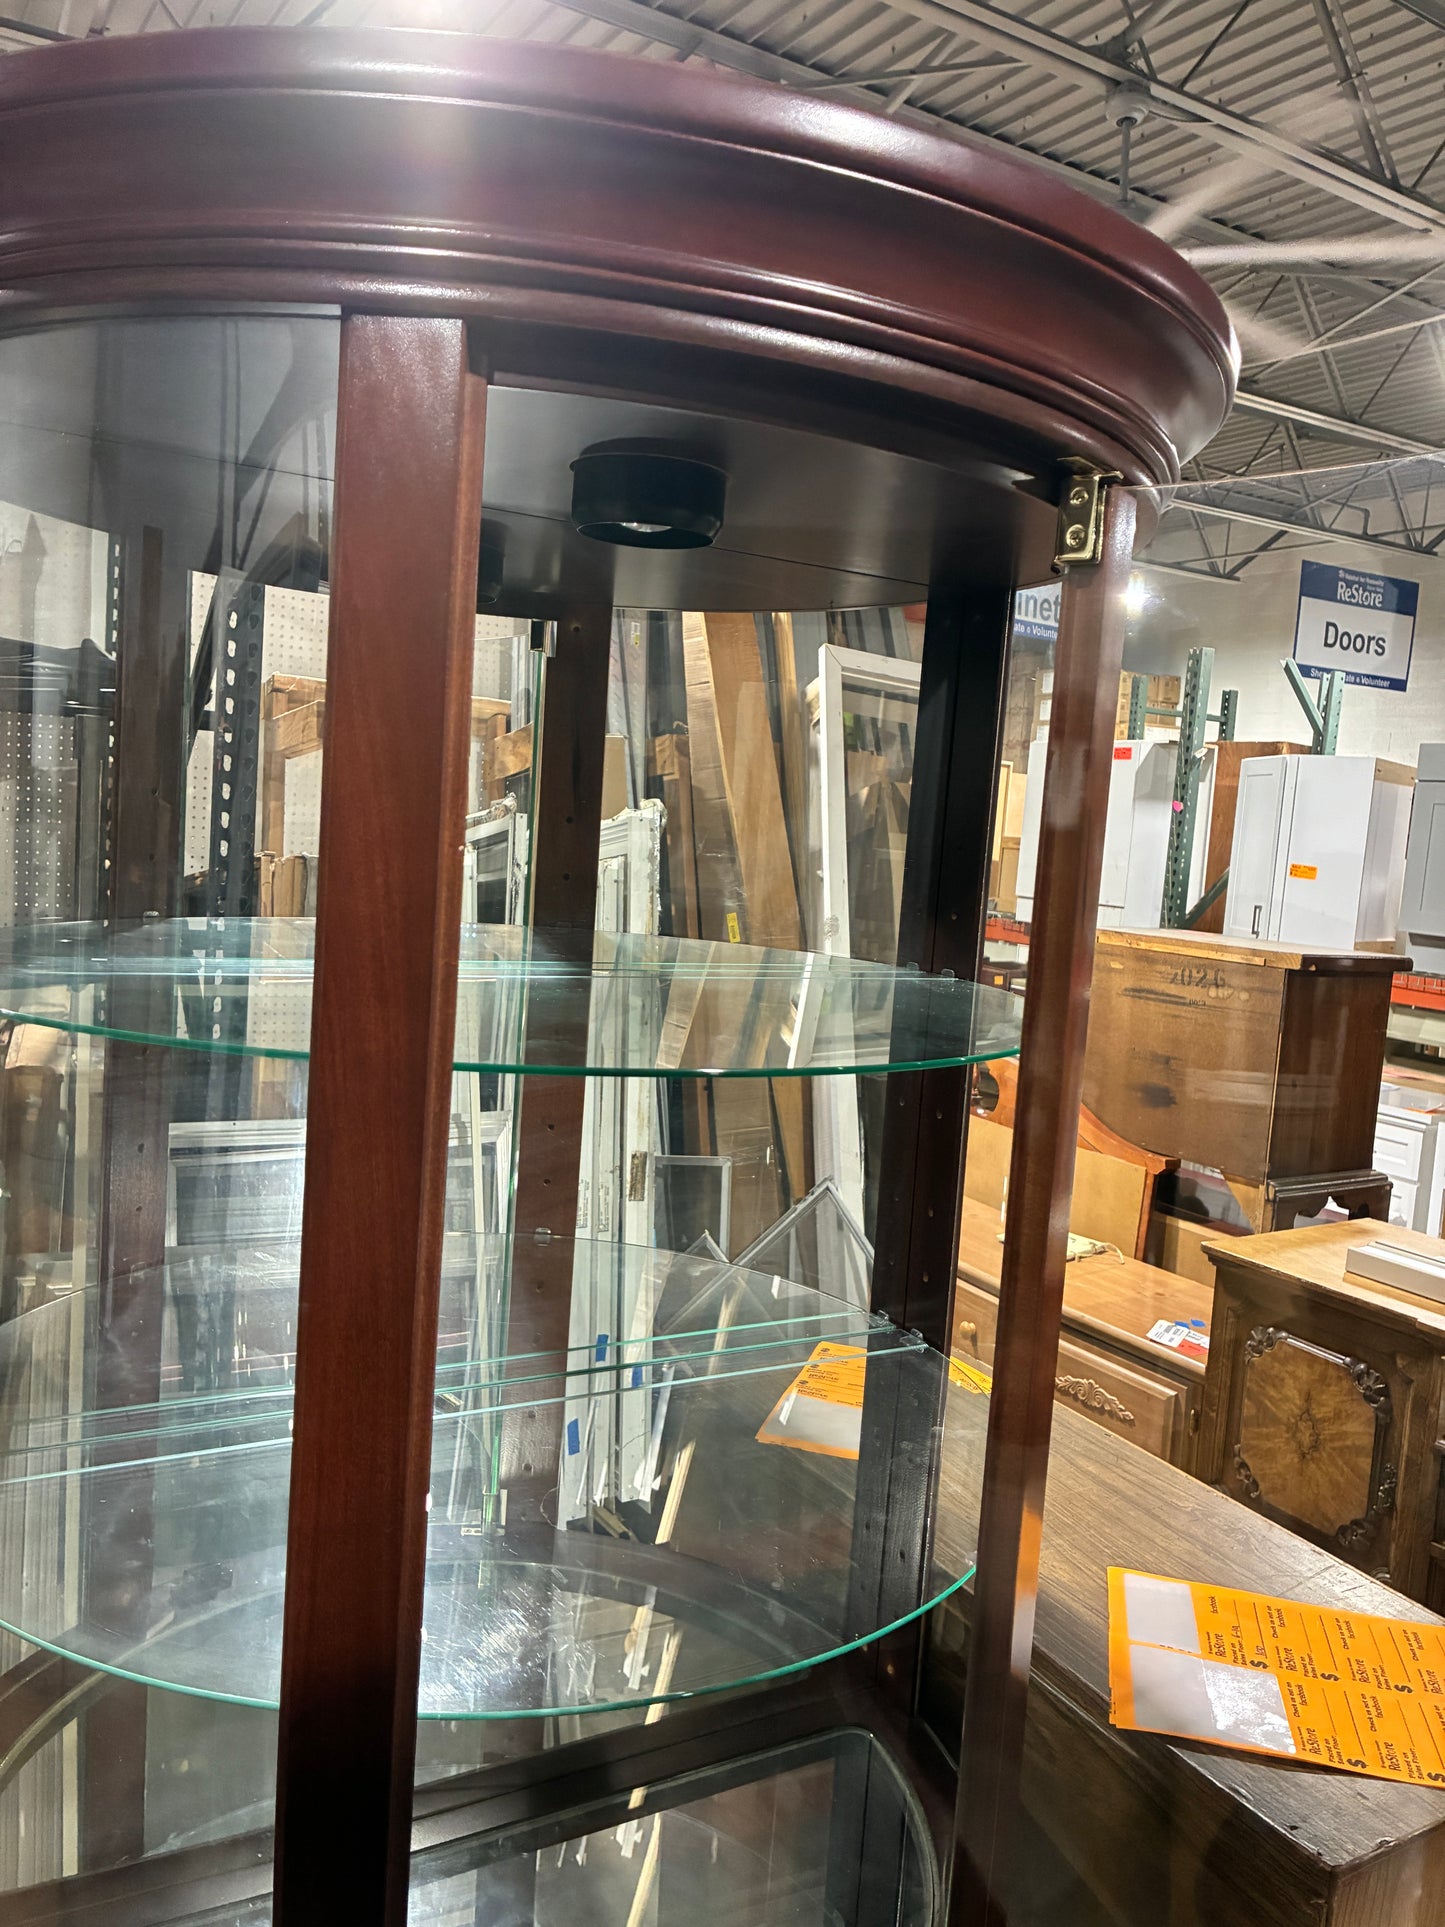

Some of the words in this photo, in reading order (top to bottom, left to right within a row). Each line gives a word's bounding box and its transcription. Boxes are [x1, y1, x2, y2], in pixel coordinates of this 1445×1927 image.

[1337, 581, 1383, 607] ReStore
[1018, 592, 1060, 622] inet
[1323, 621, 1387, 656] Doors
[1361, 675, 1390, 687] Volunteer
[1214, 1634, 1227, 1657] ReStore
[1250, 1660, 1270, 1669] $
[1284, 1648, 1298, 1672] ReStore
[1355, 1659, 1371, 1683] ReStore
[1321, 1673, 1341, 1681] $
[1374, 1674, 1383, 1689] Placed
[1426, 1670, 1443, 1694] ReStore
[1394, 1685, 1414, 1693] $
[1306, 1728, 1322, 1755] ReStore
[1325, 1746, 1335, 1763] Placed
[1347, 1759, 1368, 1768] $
[1384, 1742, 1401, 1771] ReStore
[1405, 1760, 1416, 1779] Placed
